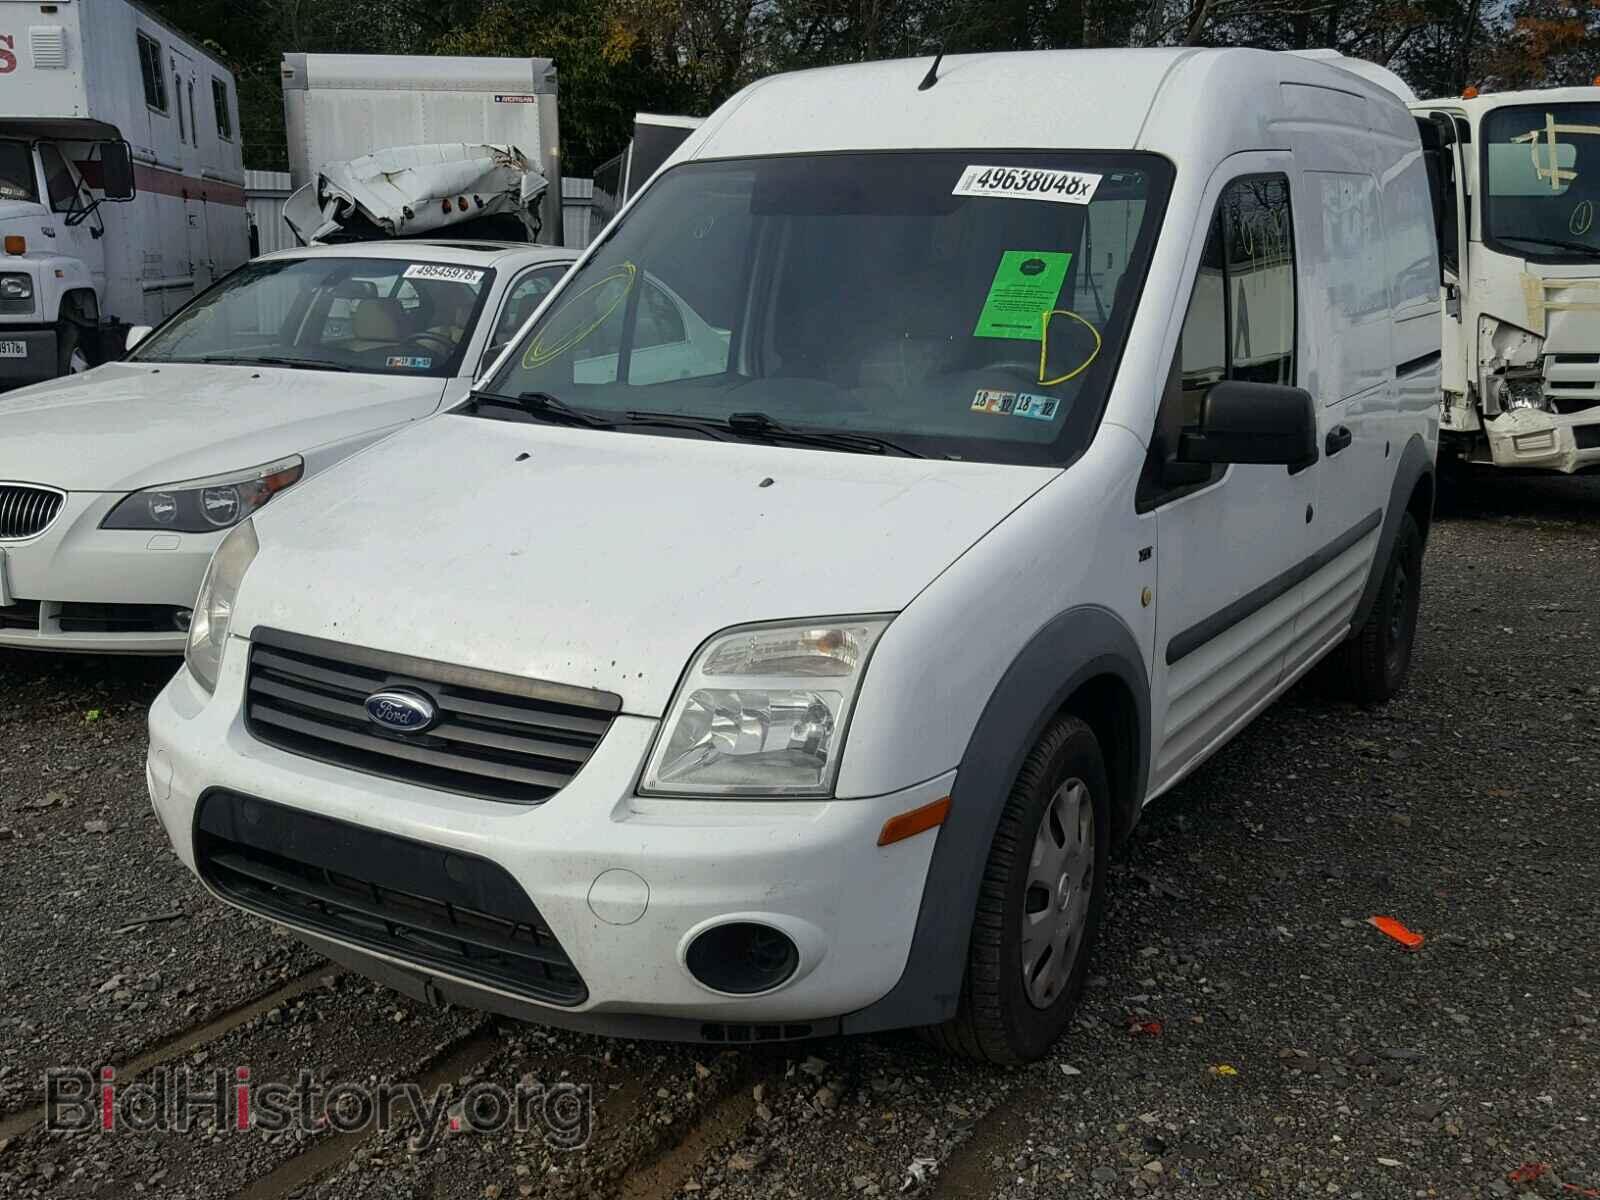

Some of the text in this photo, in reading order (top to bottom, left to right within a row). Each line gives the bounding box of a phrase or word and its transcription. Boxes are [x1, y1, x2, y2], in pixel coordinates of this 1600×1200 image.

[974, 391, 988, 407] 18
[1017, 395, 1055, 416] 18 12
[375, 700, 413, 724] Ford
